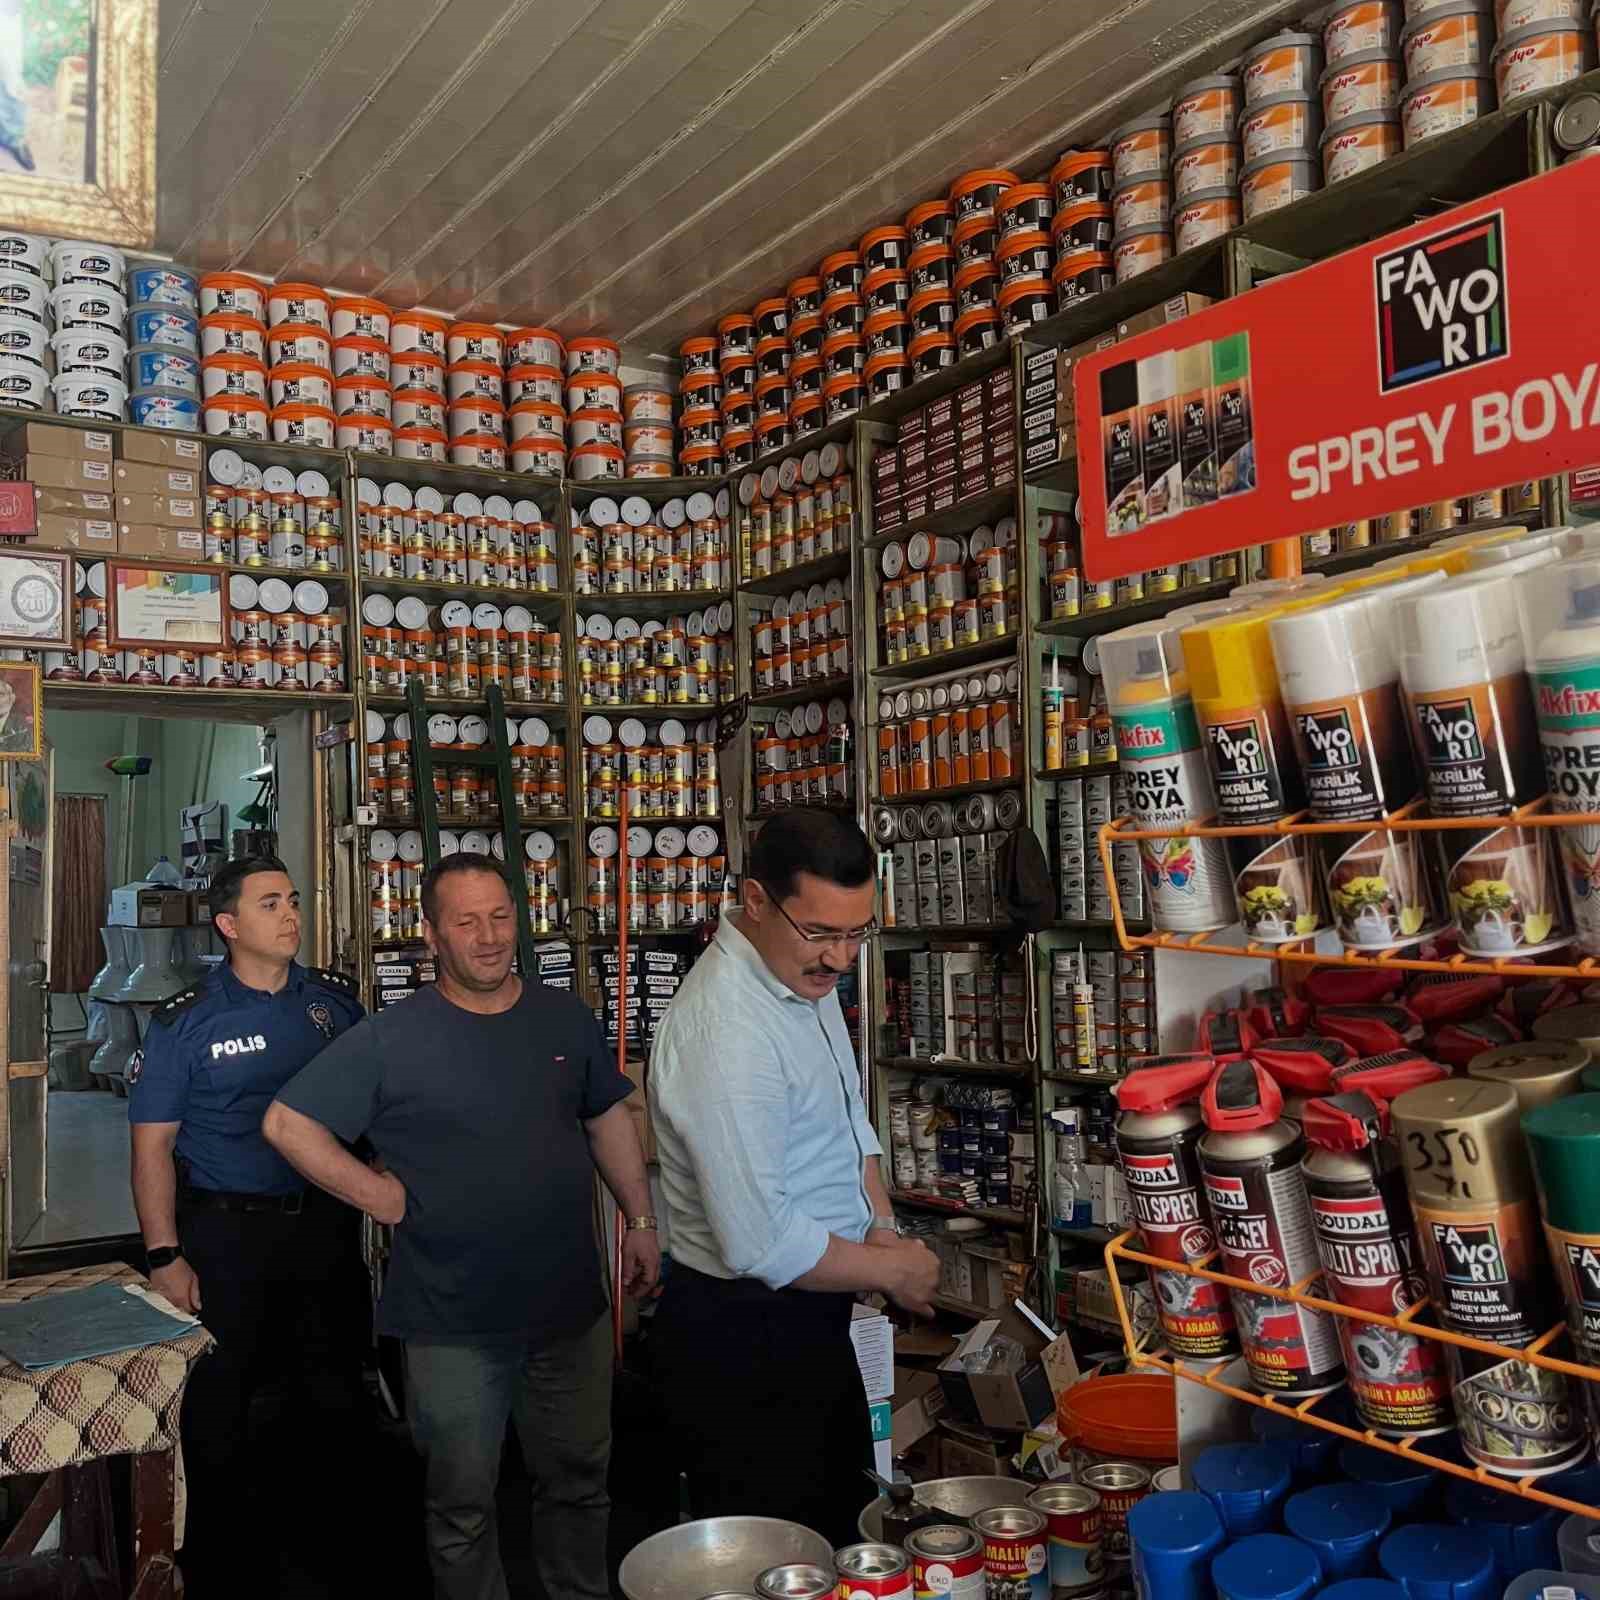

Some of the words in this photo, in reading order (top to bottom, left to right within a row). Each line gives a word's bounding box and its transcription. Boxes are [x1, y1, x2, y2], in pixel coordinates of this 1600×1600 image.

[1508, 48, 1535, 64] dyo
[1334, 75, 1357, 89] dyo
[1334, 136, 1358, 150] dyo
[1182, 210, 1200, 223] dyo
[1288, 403, 1456, 500] SPREY
[1472, 362, 1600, 455] BOY
[1546, 745, 1600, 768] PRE
[1408, 1128, 1480, 1171] 350
[1127, 1167, 1176, 1182] OUDAL
[1150, 1191, 1200, 1224] SPREY
[1317, 1212, 1388, 1230] SOUDAL
[1481, 1304, 1509, 1314] BOYA
[1185, 1320, 1218, 1334] ARADA
[1396, 1386, 1434, 1402] ARADA
